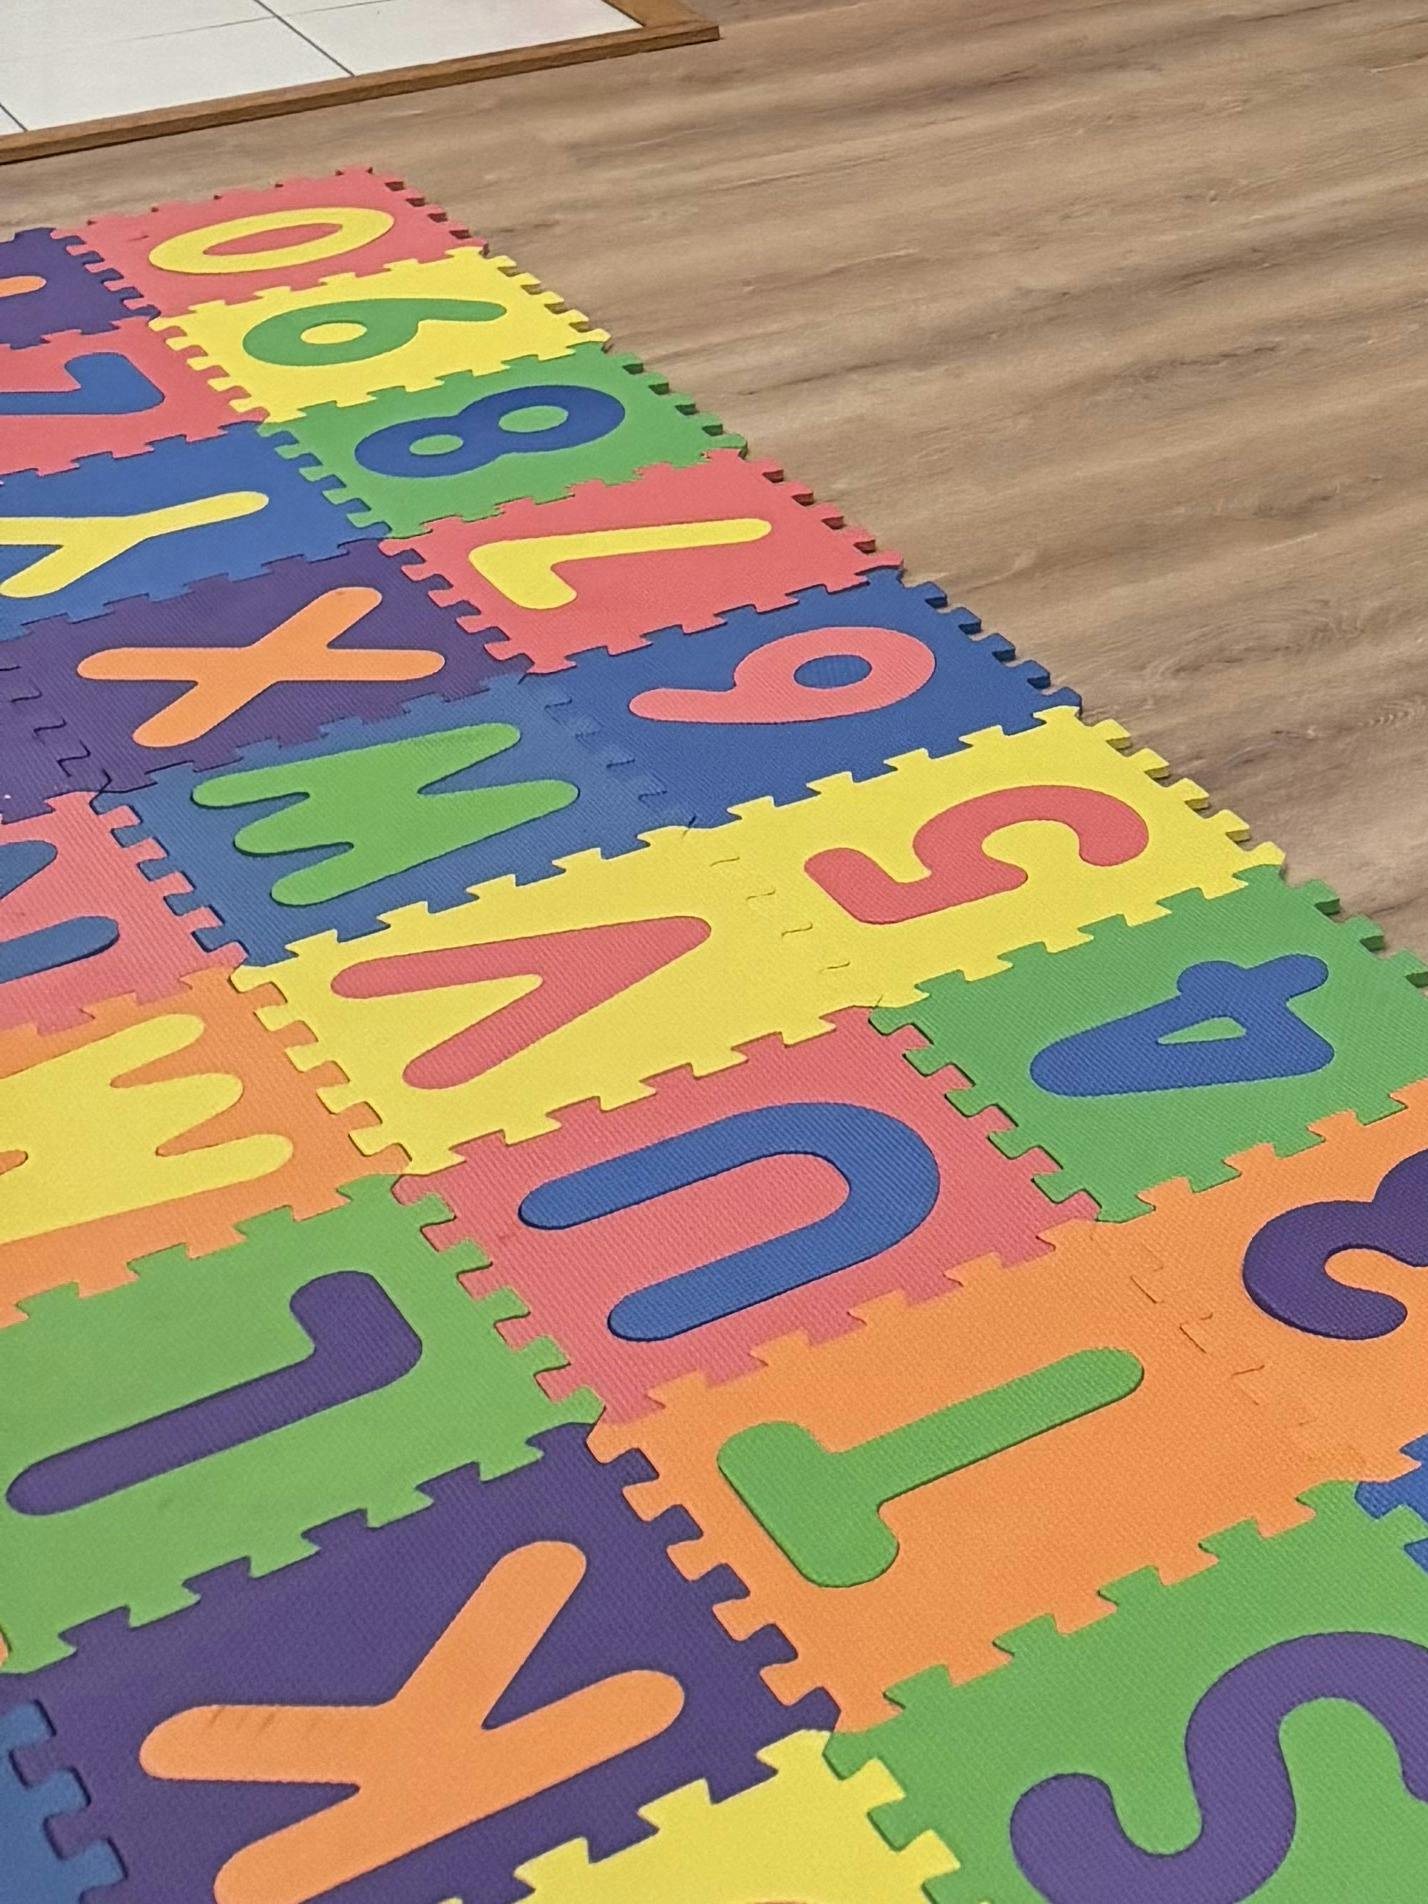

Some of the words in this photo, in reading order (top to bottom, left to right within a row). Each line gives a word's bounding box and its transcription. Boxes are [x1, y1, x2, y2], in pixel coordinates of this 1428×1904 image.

[242, 298, 507, 367] 9
[355, 384, 625, 478] 8
[469, 517, 772, 610] 7
[77, 587, 446, 748] X
[629, 626, 937, 724] 6
[192, 722, 580, 906] W
[804, 786, 1150, 925] 5
[331, 914, 712, 1090] V
[1030, 952, 1336, 1099] 4
[518, 1100, 941, 1342] U
[5, 1270, 423, 1516] L
[717, 1347, 1146, 1588] T
[138, 1539, 687, 1904] K
